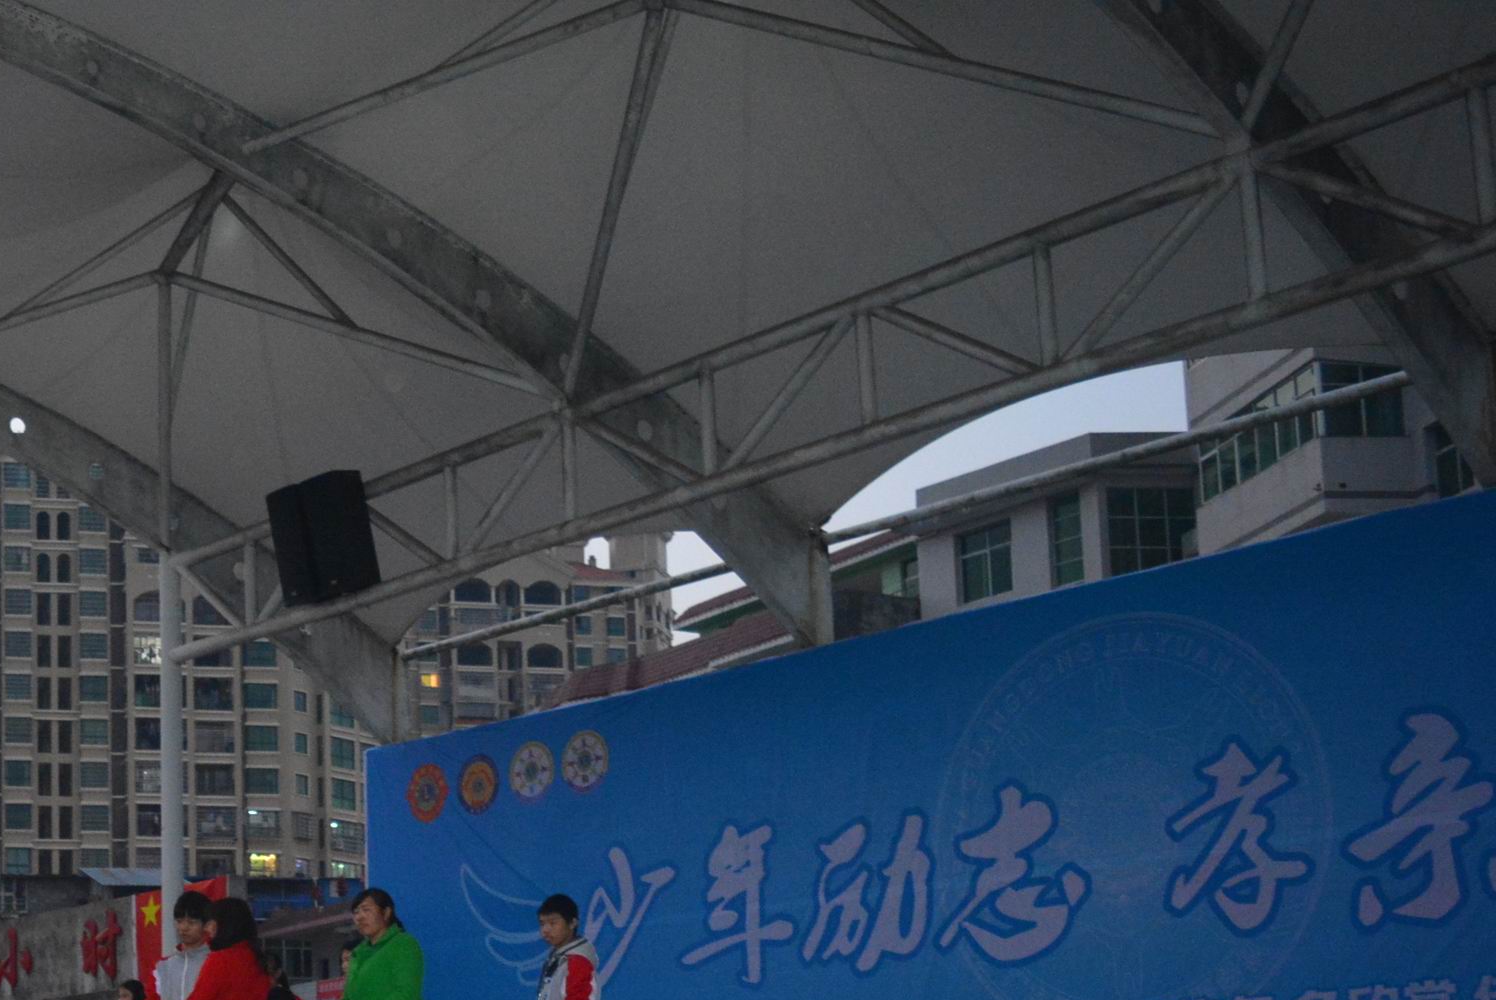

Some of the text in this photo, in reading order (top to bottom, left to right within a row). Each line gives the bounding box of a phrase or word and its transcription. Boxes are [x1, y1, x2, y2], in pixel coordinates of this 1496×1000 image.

[583, 712, 1496, 986] 少年励志 孝亲
